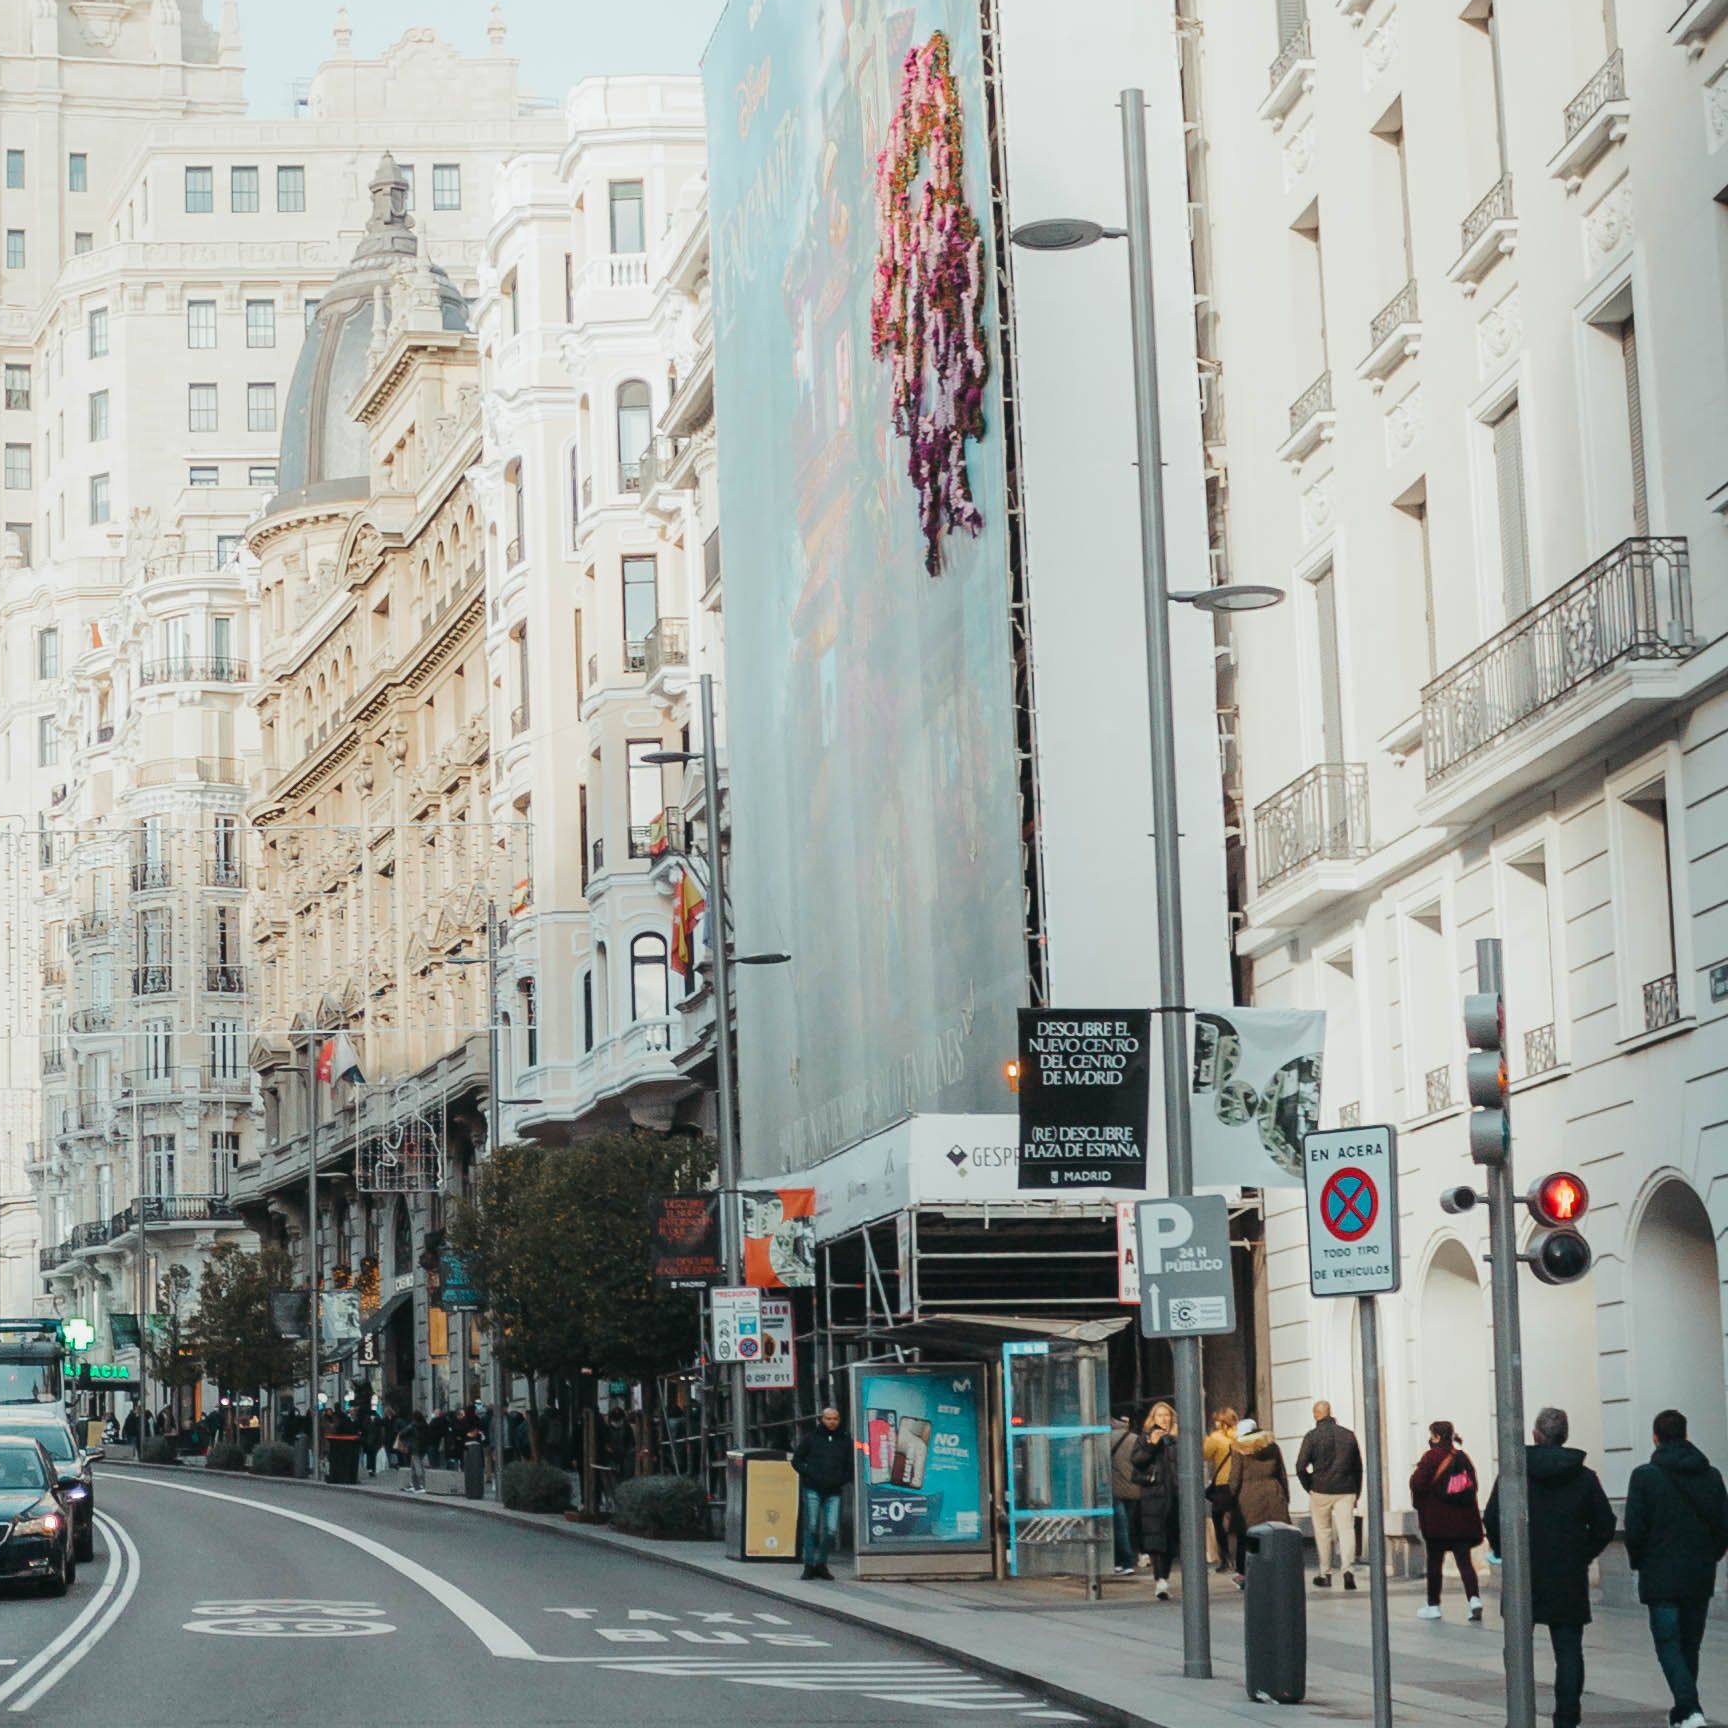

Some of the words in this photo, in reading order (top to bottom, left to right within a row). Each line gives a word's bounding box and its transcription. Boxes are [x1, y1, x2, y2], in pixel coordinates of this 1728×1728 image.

[1037, 1022, 1112, 1036] DESCUBRE
[1115, 1022, 1131, 1036] EL
[1029, 1038, 1080, 1053] NUEVO
[1082, 1038, 1140, 1053] CENTRO
[1040, 1055, 1067, 1069] DEL
[1069, 1054, 1127, 1069] CENTRO
[1042, 1071, 1062, 1085] DE
[1065, 1070, 1123, 1085] MADRID
[1032, 1126, 1057, 1143] (RE)
[1059, 1127, 1133, 1142] DESCUBRE
[1024, 1143, 1062, 1158] PLAZA
[1065, 1143, 1084, 1157] DE
[1086, 1141, 1141, 1158] ESPAÑA
[1311, 1149, 1329, 1162] EN
[1338, 1143, 1384, 1159] ACERA
[1064, 1171, 1112, 1181] MADRID
[1140, 1202, 1194, 1275] P
[1178, 1246, 1193, 1259] 24
[1196, 1246, 1207, 1257] H
[1323, 1247, 1351, 1259] TODO
[1357, 1245, 1379, 1256] TIPO
[1164, 1258, 1223, 1273] PÚBLICO
[1314, 1268, 1327, 1280] DE
[1332, 1264, 1391, 1278] VEHÍCULOS
[934, 1433, 960, 1447] NO
[542, 1607, 793, 1626] TAXI
[593, 1628, 833, 1648] BUS
